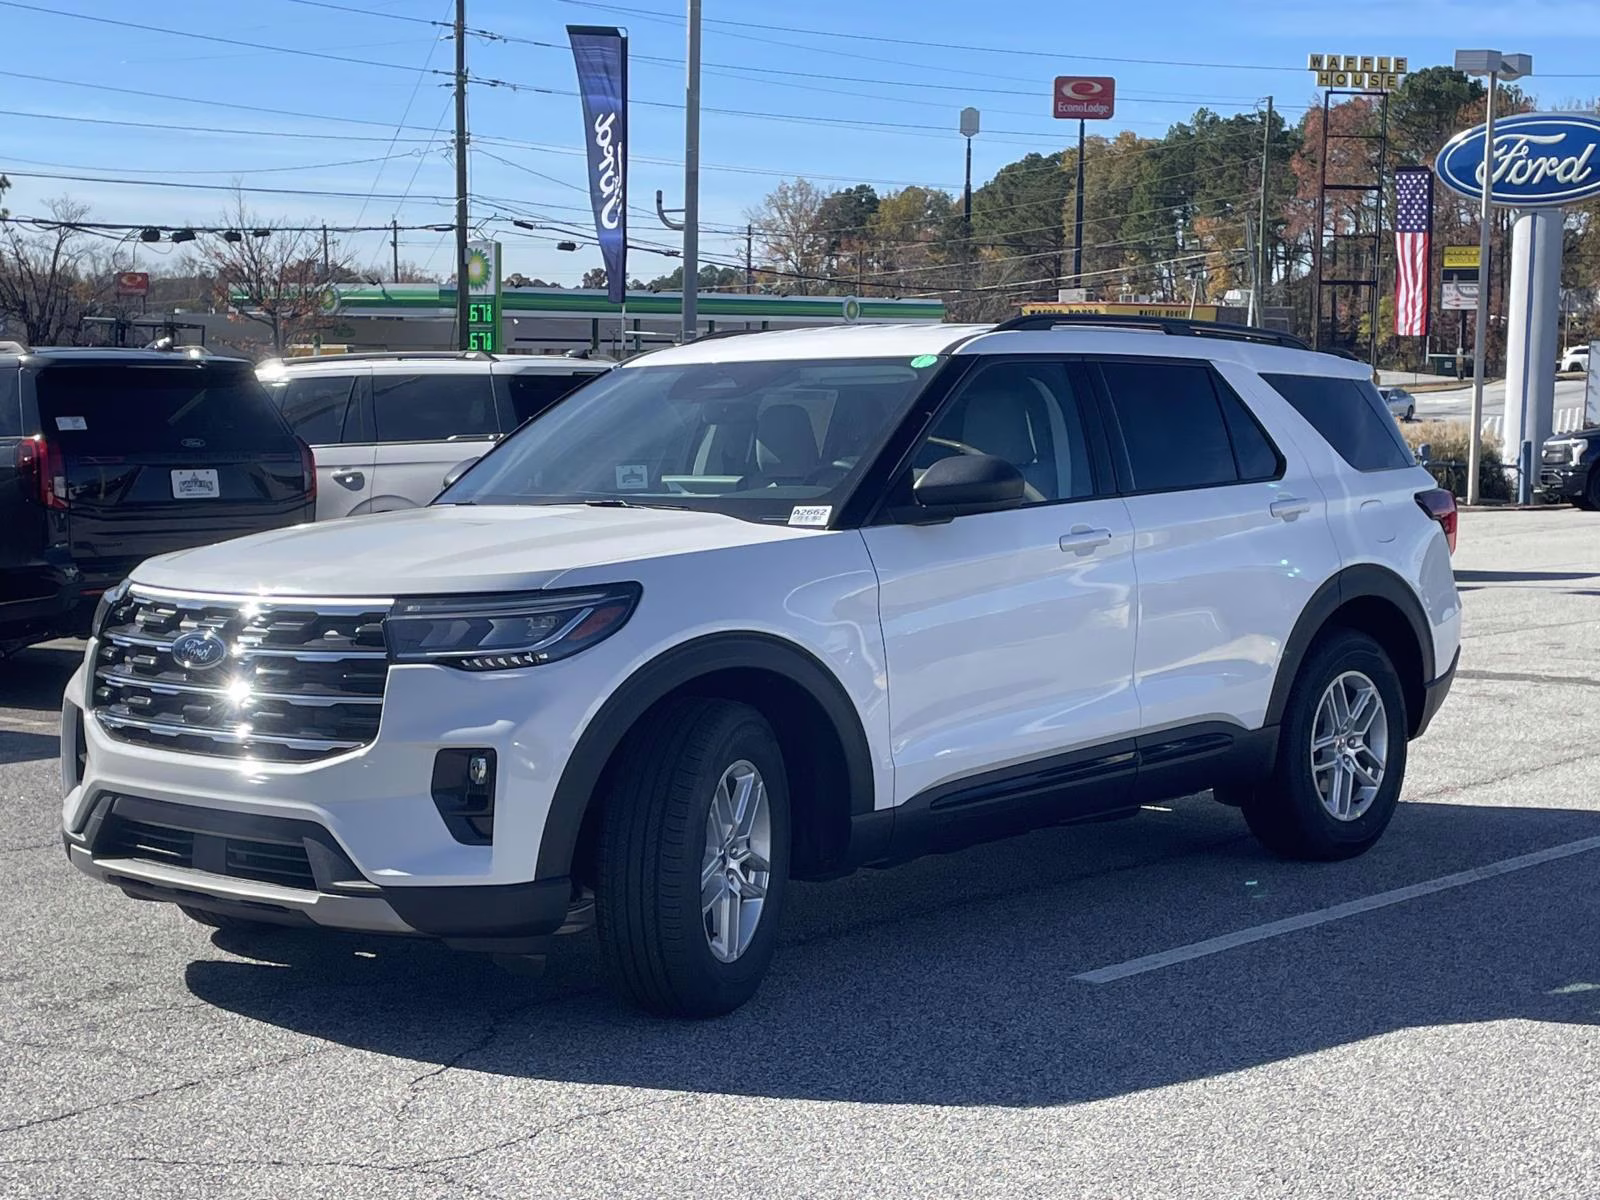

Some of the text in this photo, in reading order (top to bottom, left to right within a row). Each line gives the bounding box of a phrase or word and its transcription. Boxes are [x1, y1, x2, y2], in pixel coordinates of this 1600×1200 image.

[1310, 57, 1405, 70] WAFFLE
[1320, 73, 1396, 86] HOUSE
[1475, 133, 1597, 185] Ford
[181, 638, 213, 660] Ford
